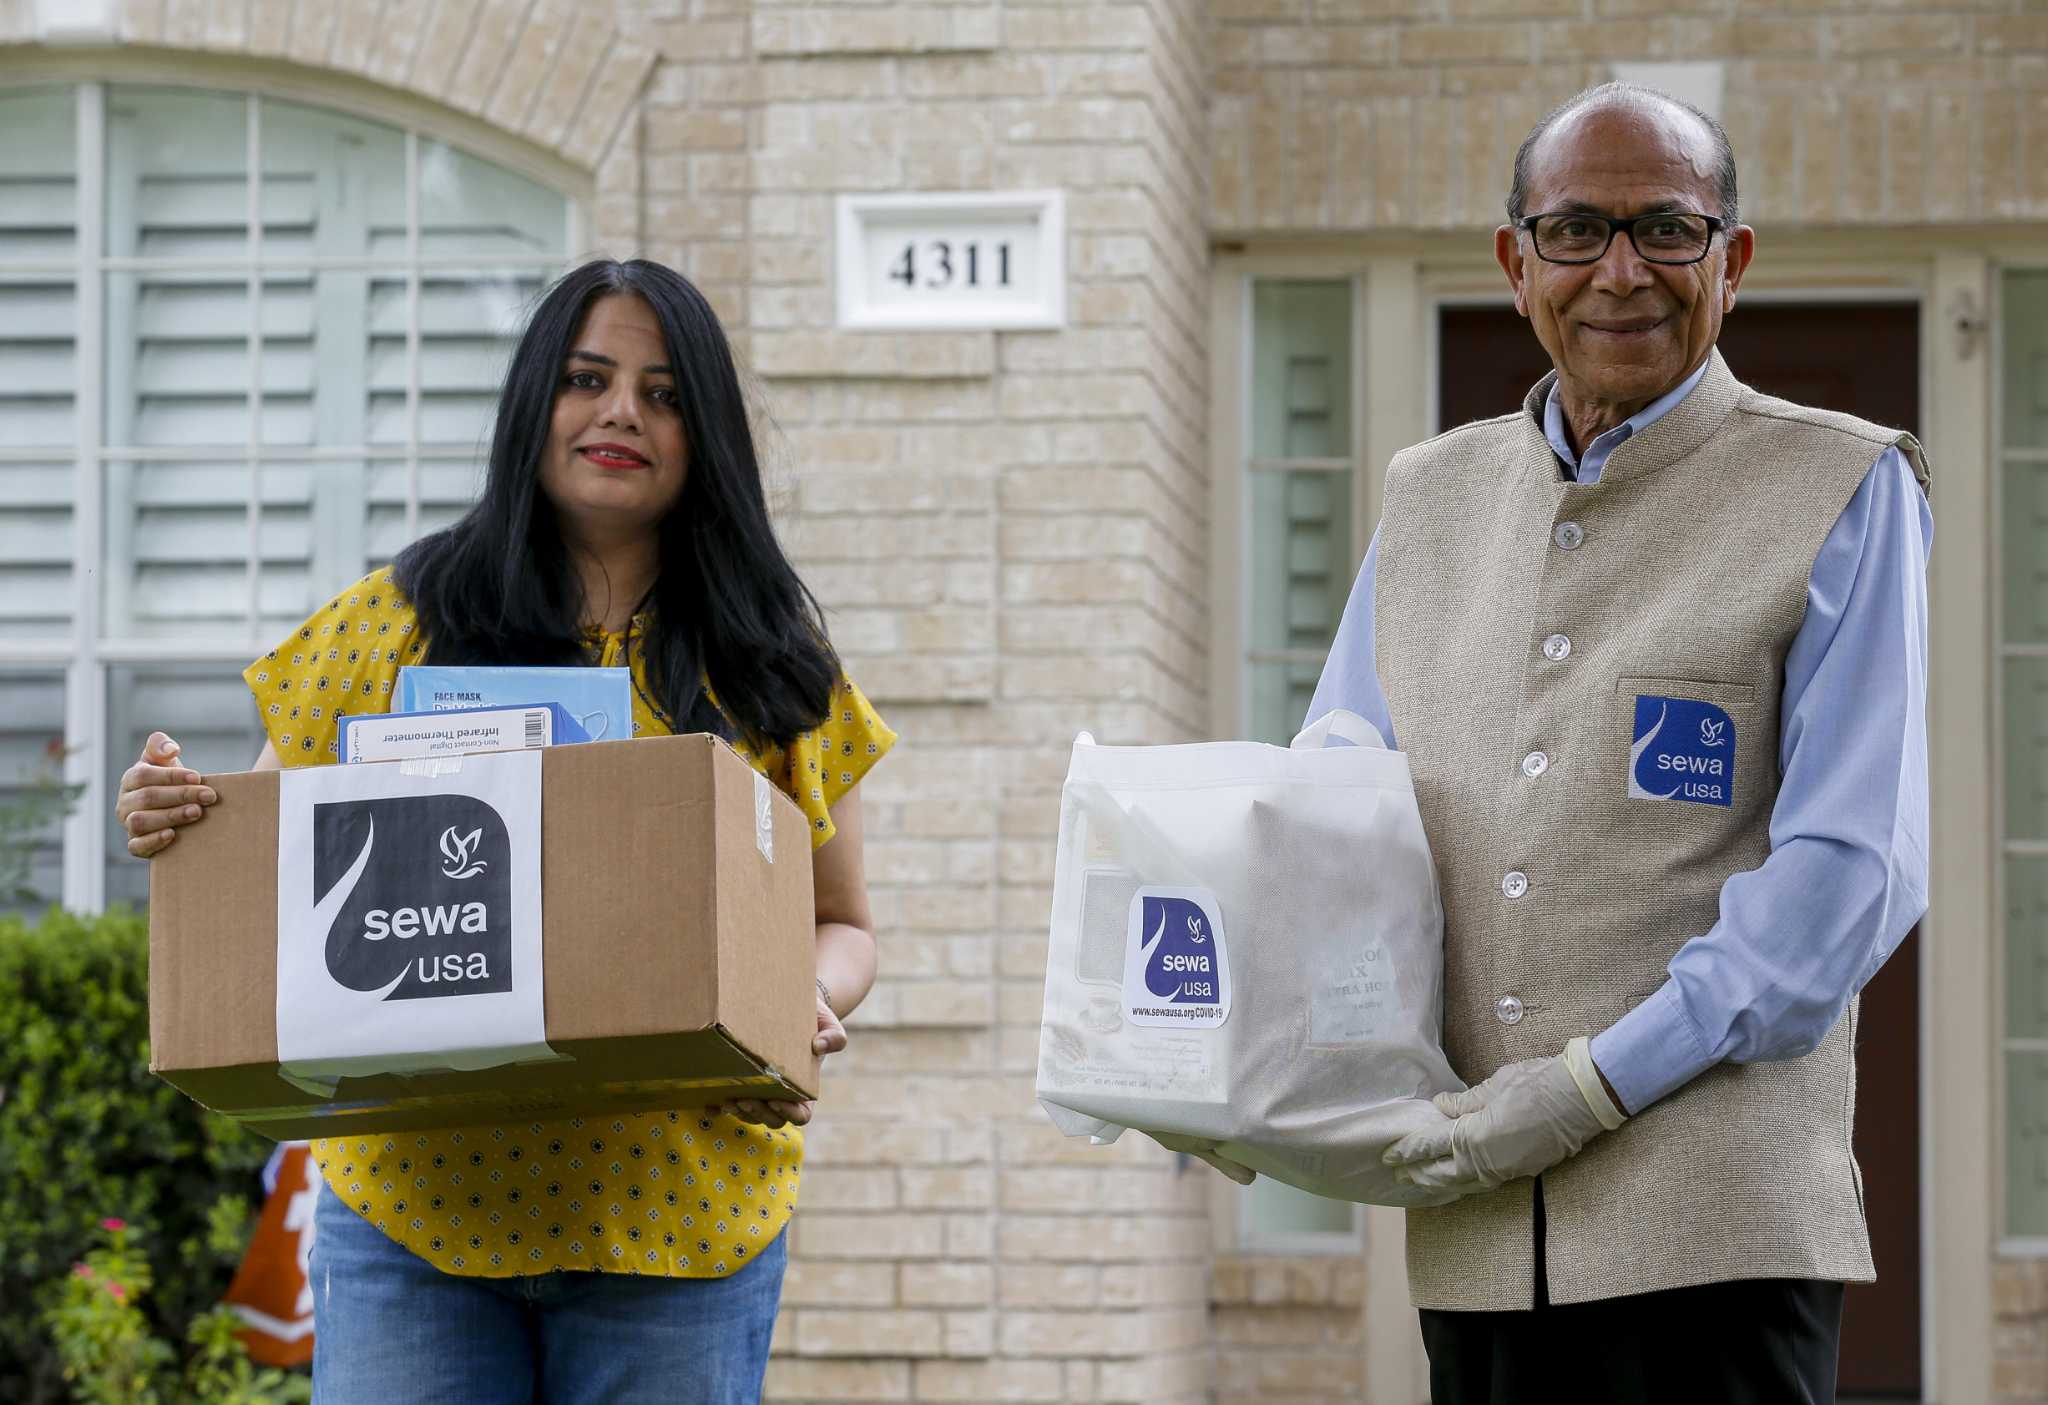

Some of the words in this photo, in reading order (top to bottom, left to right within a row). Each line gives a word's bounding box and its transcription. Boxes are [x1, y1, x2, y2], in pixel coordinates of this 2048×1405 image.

[889, 240, 1013, 288] 4311
[434, 692, 454, 701] FACE
[457, 692, 481, 701] MASK
[383, 729, 455, 743] Thermometer
[457, 728, 499, 740] Infrared
[430, 741, 453, 751] Digital
[455, 739, 499, 750] Non-Contact
[1656, 753, 1723, 776] sewa
[1684, 782, 1722, 799] usa
[363, 900, 487, 941] sewa
[418, 952, 489, 983] usa
[1162, 952, 1210, 973] sewa
[1184, 979, 1212, 997] usa
